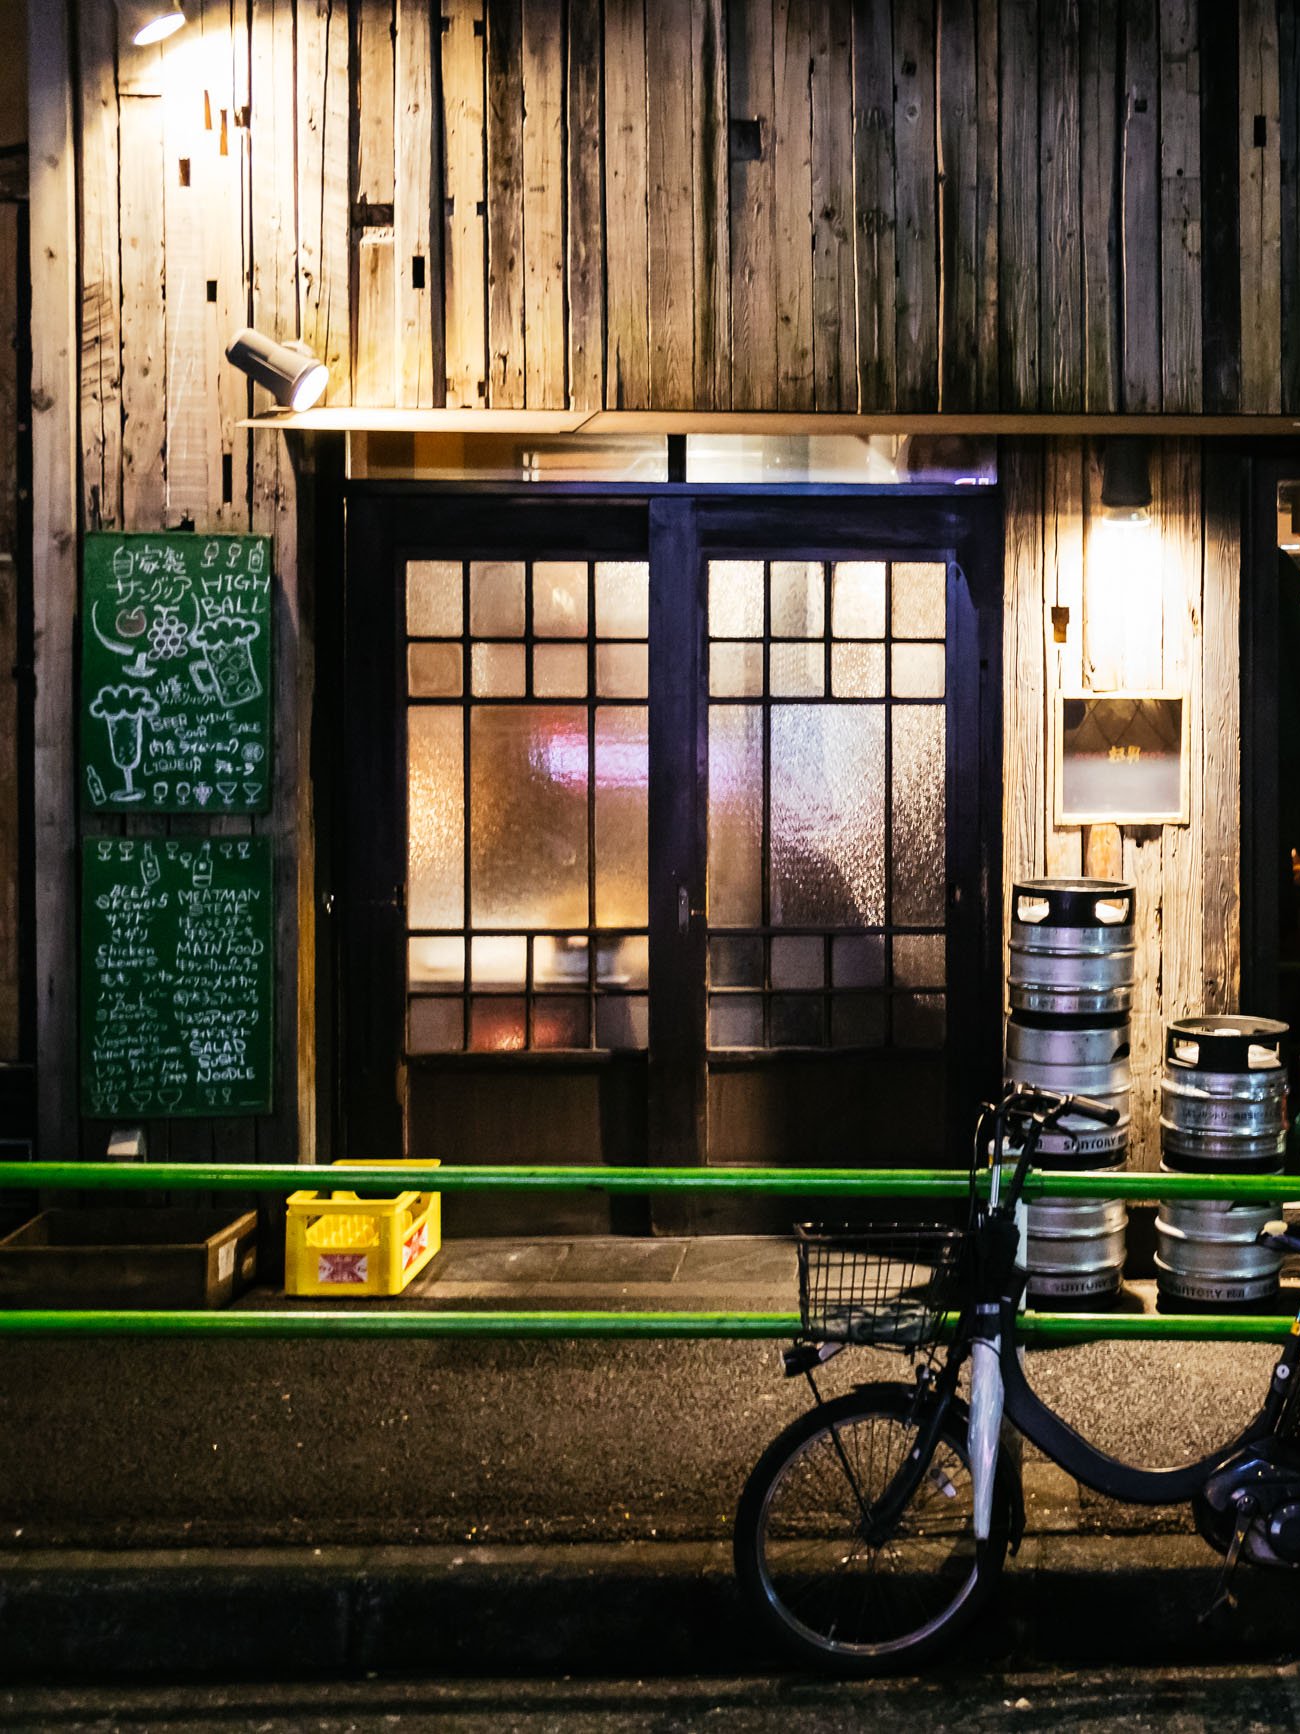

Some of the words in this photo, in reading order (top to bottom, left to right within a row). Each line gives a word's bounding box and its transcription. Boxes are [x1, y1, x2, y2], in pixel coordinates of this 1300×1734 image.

[106, 575, 193, 605] サングリア
[201, 573, 270, 595] HIGH
[201, 595, 266, 619] BALL
[195, 709, 236, 725] WINE
[143, 756, 202, 777] LIQUEUR
[177, 887, 261, 906] MEATMAN
[189, 902, 249, 917] STEAK
[98, 943, 155, 957] Chicken
[176, 940, 223, 957] MAIN
[189, 1037, 247, 1056] SALAD
